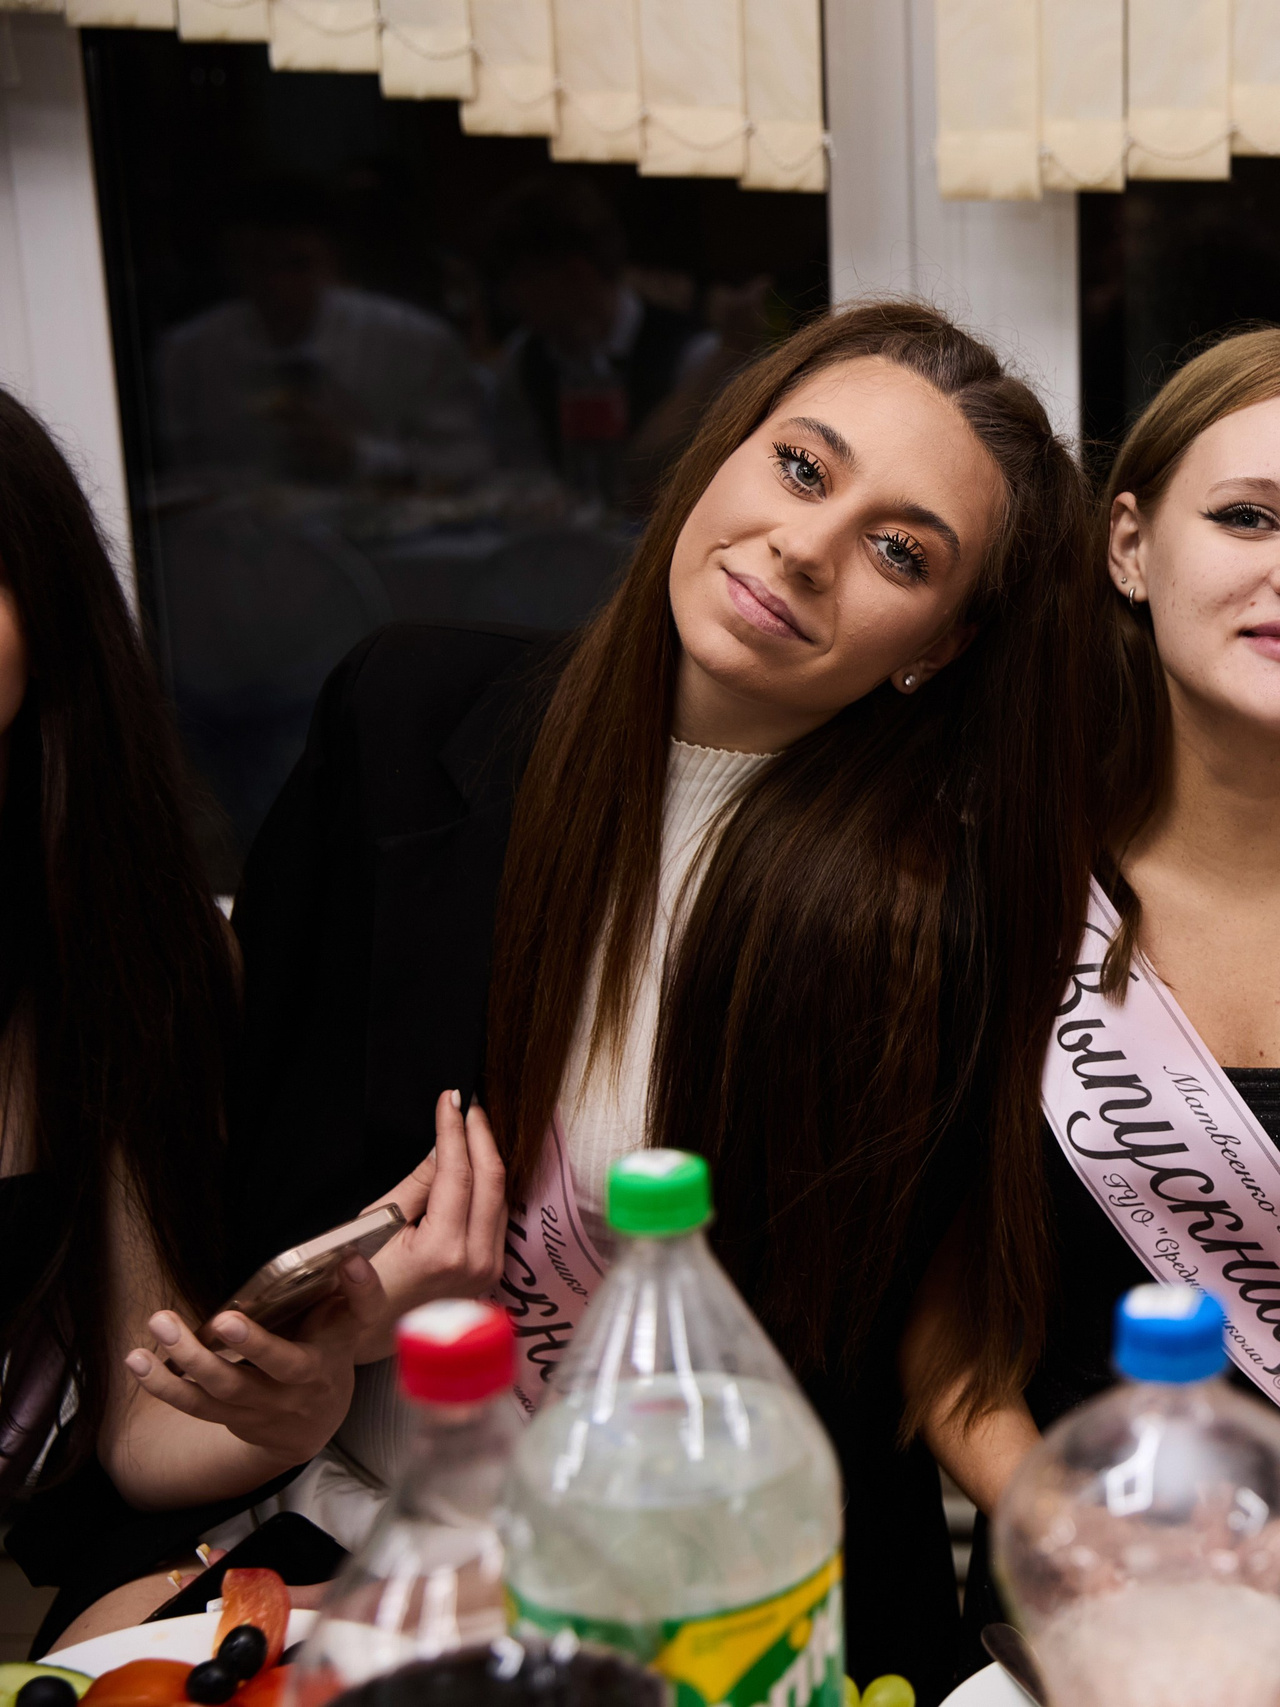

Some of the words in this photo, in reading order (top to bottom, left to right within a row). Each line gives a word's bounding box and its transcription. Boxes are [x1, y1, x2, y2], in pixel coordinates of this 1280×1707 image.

[1163, 1065, 1278, 1217] Матвеенко
[1103, 1173, 1155, 1228] ГУО
[540, 1205, 589, 1297] Шишко
